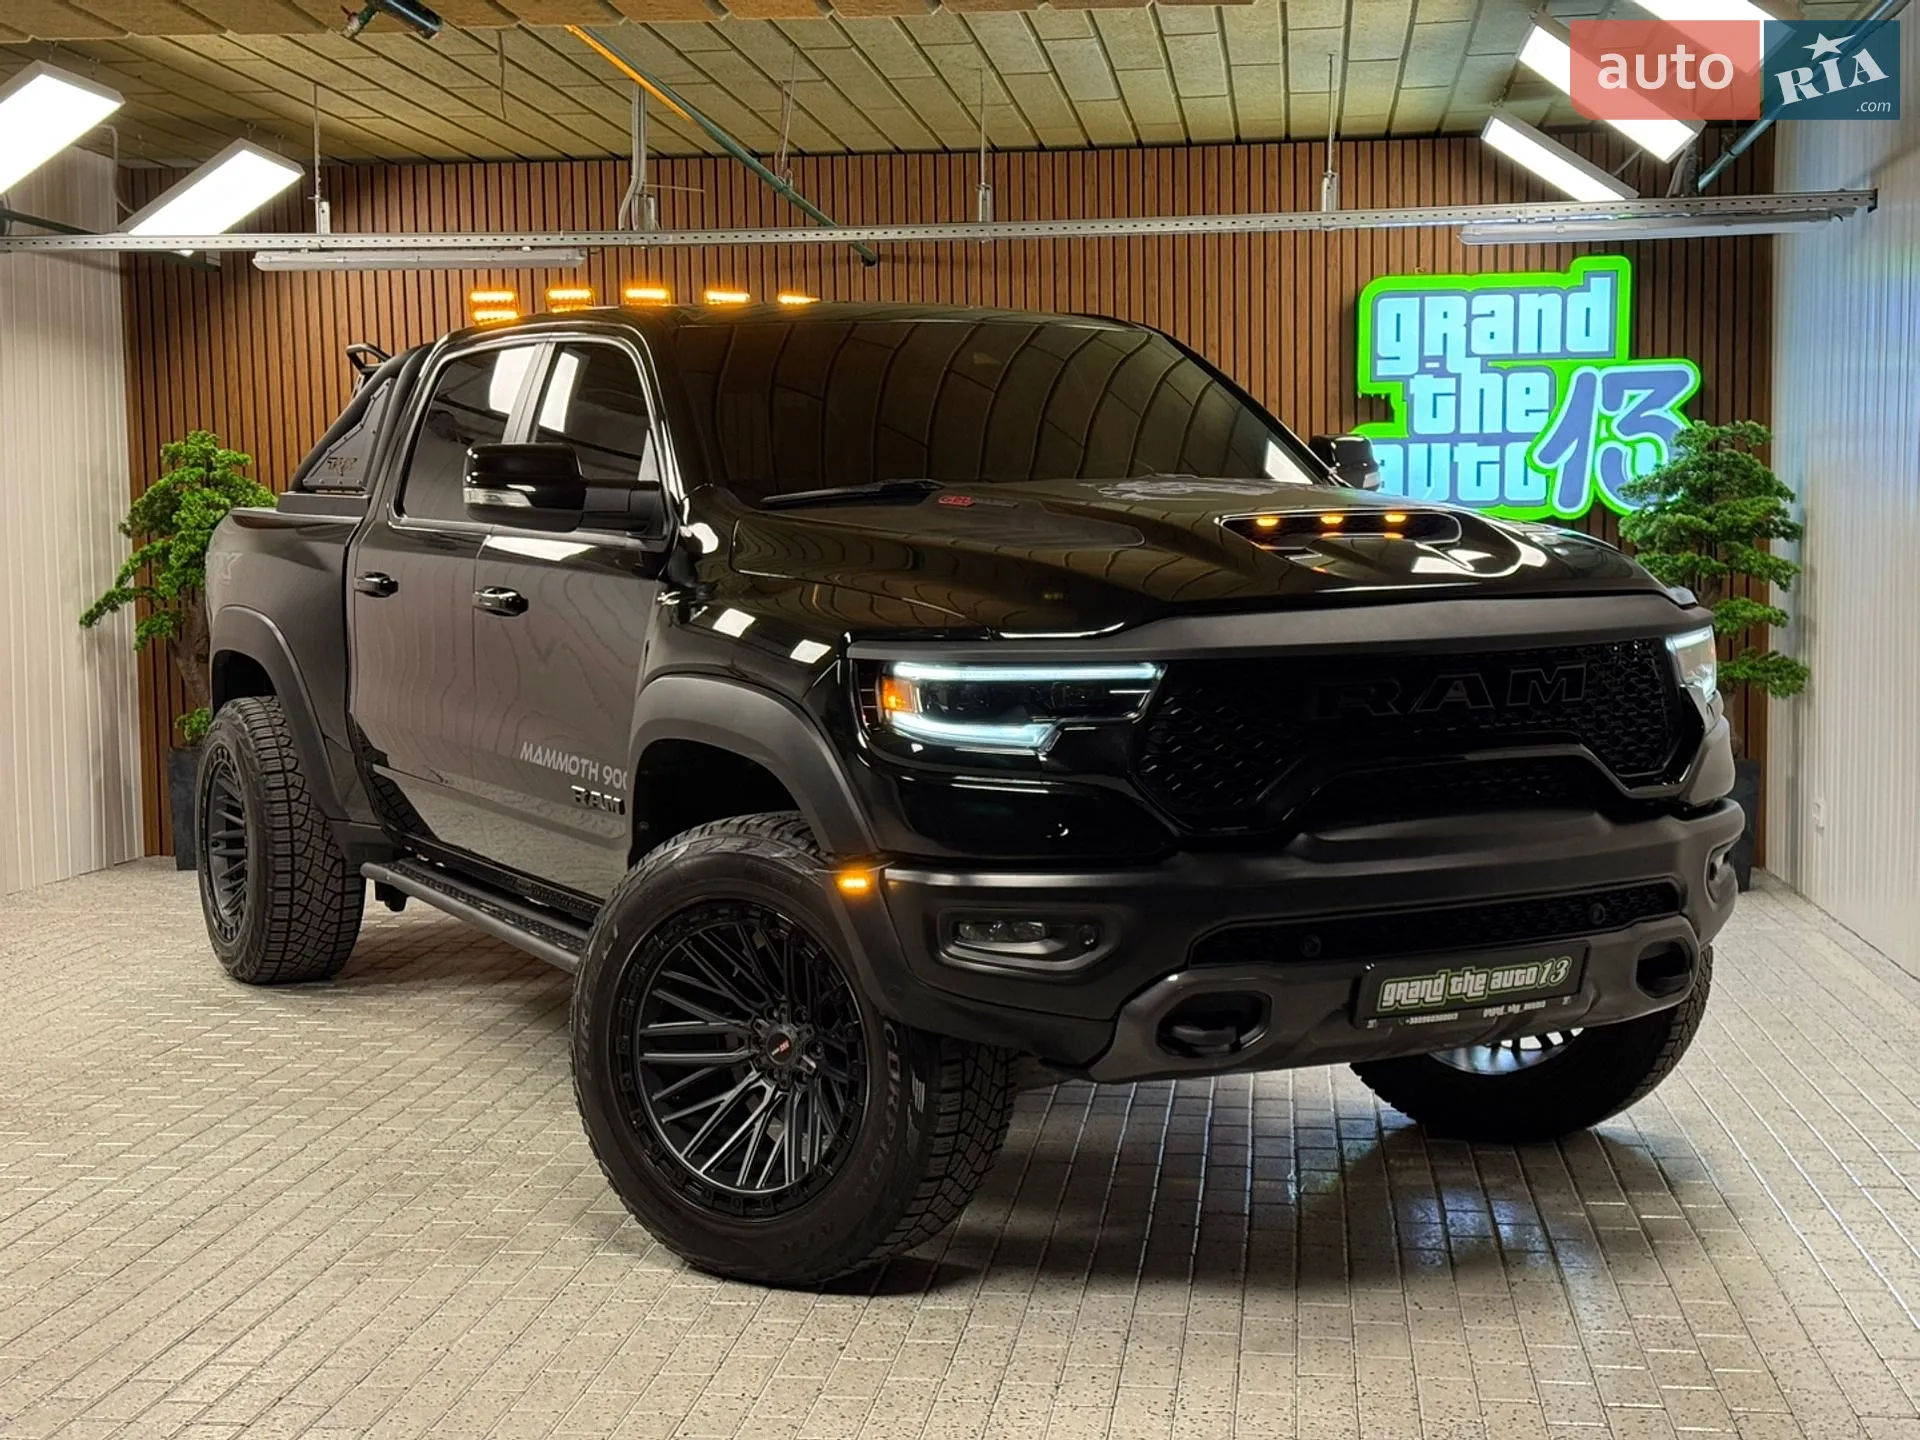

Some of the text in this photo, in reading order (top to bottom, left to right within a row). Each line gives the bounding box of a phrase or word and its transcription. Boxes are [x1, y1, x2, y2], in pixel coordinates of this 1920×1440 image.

[1408, 356, 1550, 434] the
[1533, 366, 1695, 513] 13
[1371, 441, 1547, 501] auto
[1311, 663, 1587, 720] RAM
[520, 741, 600, 783] MAMMOTH
[1449, 971, 1488, 997] the
[1490, 966, 1537, 990] auto
[1539, 959, 1569, 985] 13
